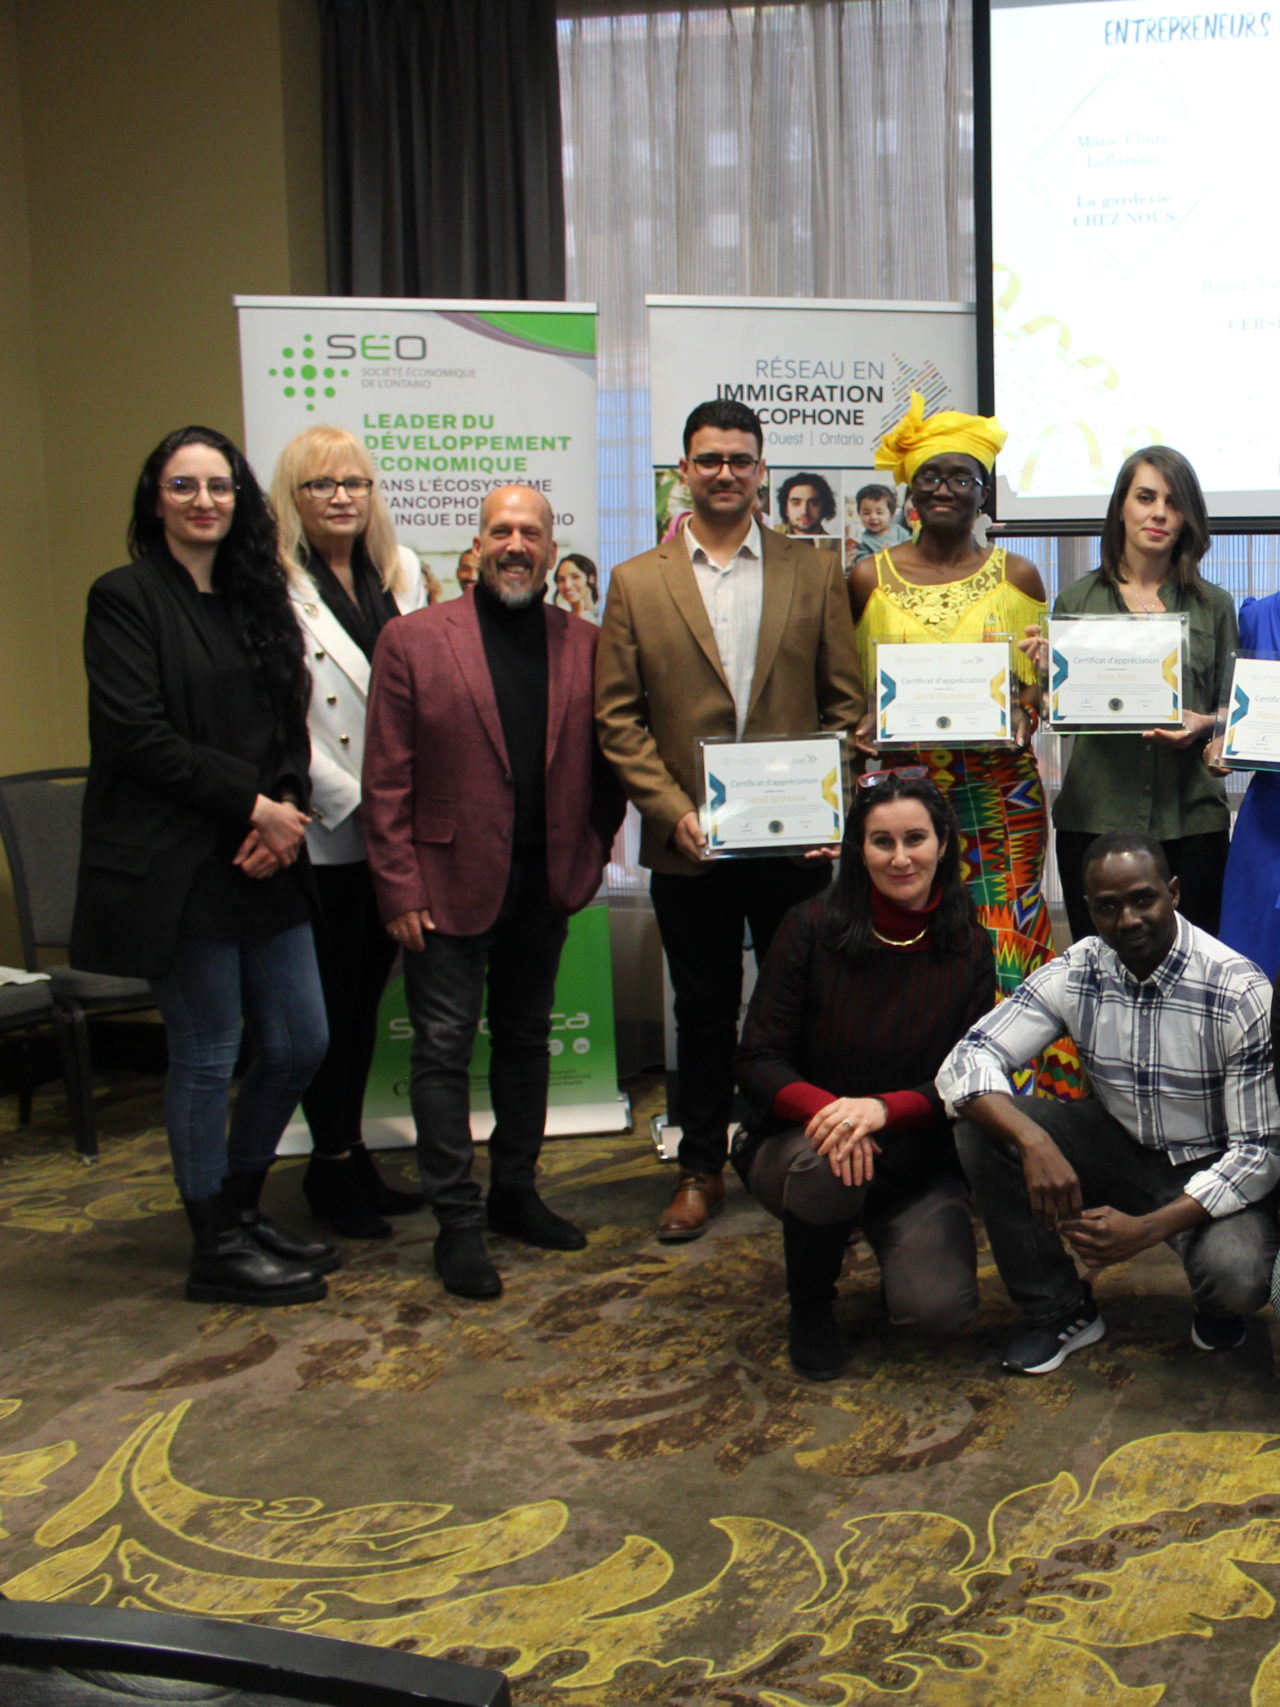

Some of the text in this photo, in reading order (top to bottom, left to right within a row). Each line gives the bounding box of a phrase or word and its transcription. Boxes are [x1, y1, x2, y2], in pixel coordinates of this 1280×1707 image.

[1103, 11, 1272, 46] ENTREPRENEURS
[1076, 192, 1173, 209] La garderie
[1072, 210, 1176, 228] CHEZ NOUS
[361, 366, 477, 379] SOCIÉTÉ ÉCONOMIQUE
[755, 355, 884, 380] RÉSEAU EN
[361, 379, 375, 389] DE
[716, 383, 883, 403] IMMIGRATION
[363, 413, 495, 430] LEADER DU
[752, 408, 864, 426] COPHONE
[363, 431, 573, 451] DÉVELOPPEMENT
[819, 432, 864, 446] Ontario
[455, 513, 479, 527] DE
[1073, 656, 1160, 666] Certificat d'appréciation
[901, 676, 934, 685] Certificat
[730, 778, 764, 788] Certificat
